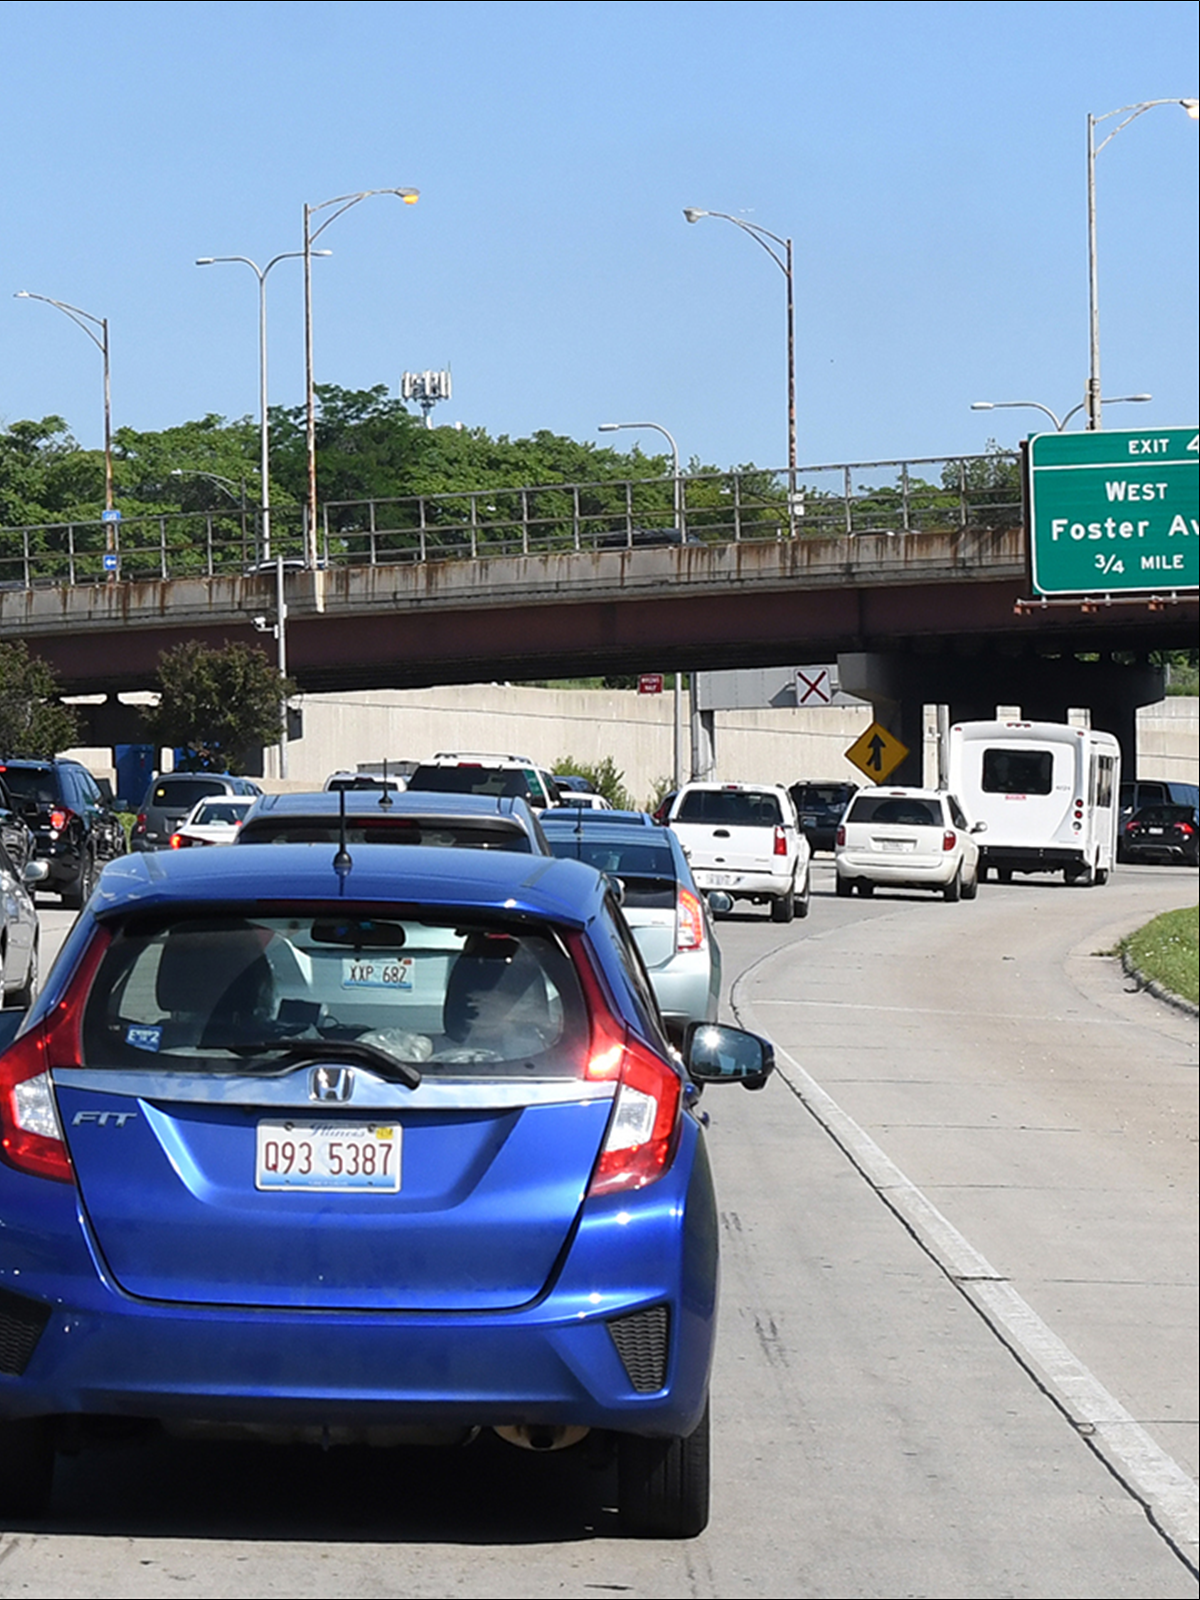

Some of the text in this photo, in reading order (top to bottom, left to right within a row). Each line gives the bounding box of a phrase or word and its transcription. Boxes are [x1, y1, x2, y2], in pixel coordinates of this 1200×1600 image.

[1128, 438, 1169, 455] EXIT
[1105, 481, 1168, 502] WEST
[1052, 517, 1150, 541] Foster
[1141, 554, 1184, 570] MILE
[350, 965, 408, 984] XXP 682
[72, 1110, 138, 1127] FIT
[265, 1141, 393, 1176] Q93 5387
